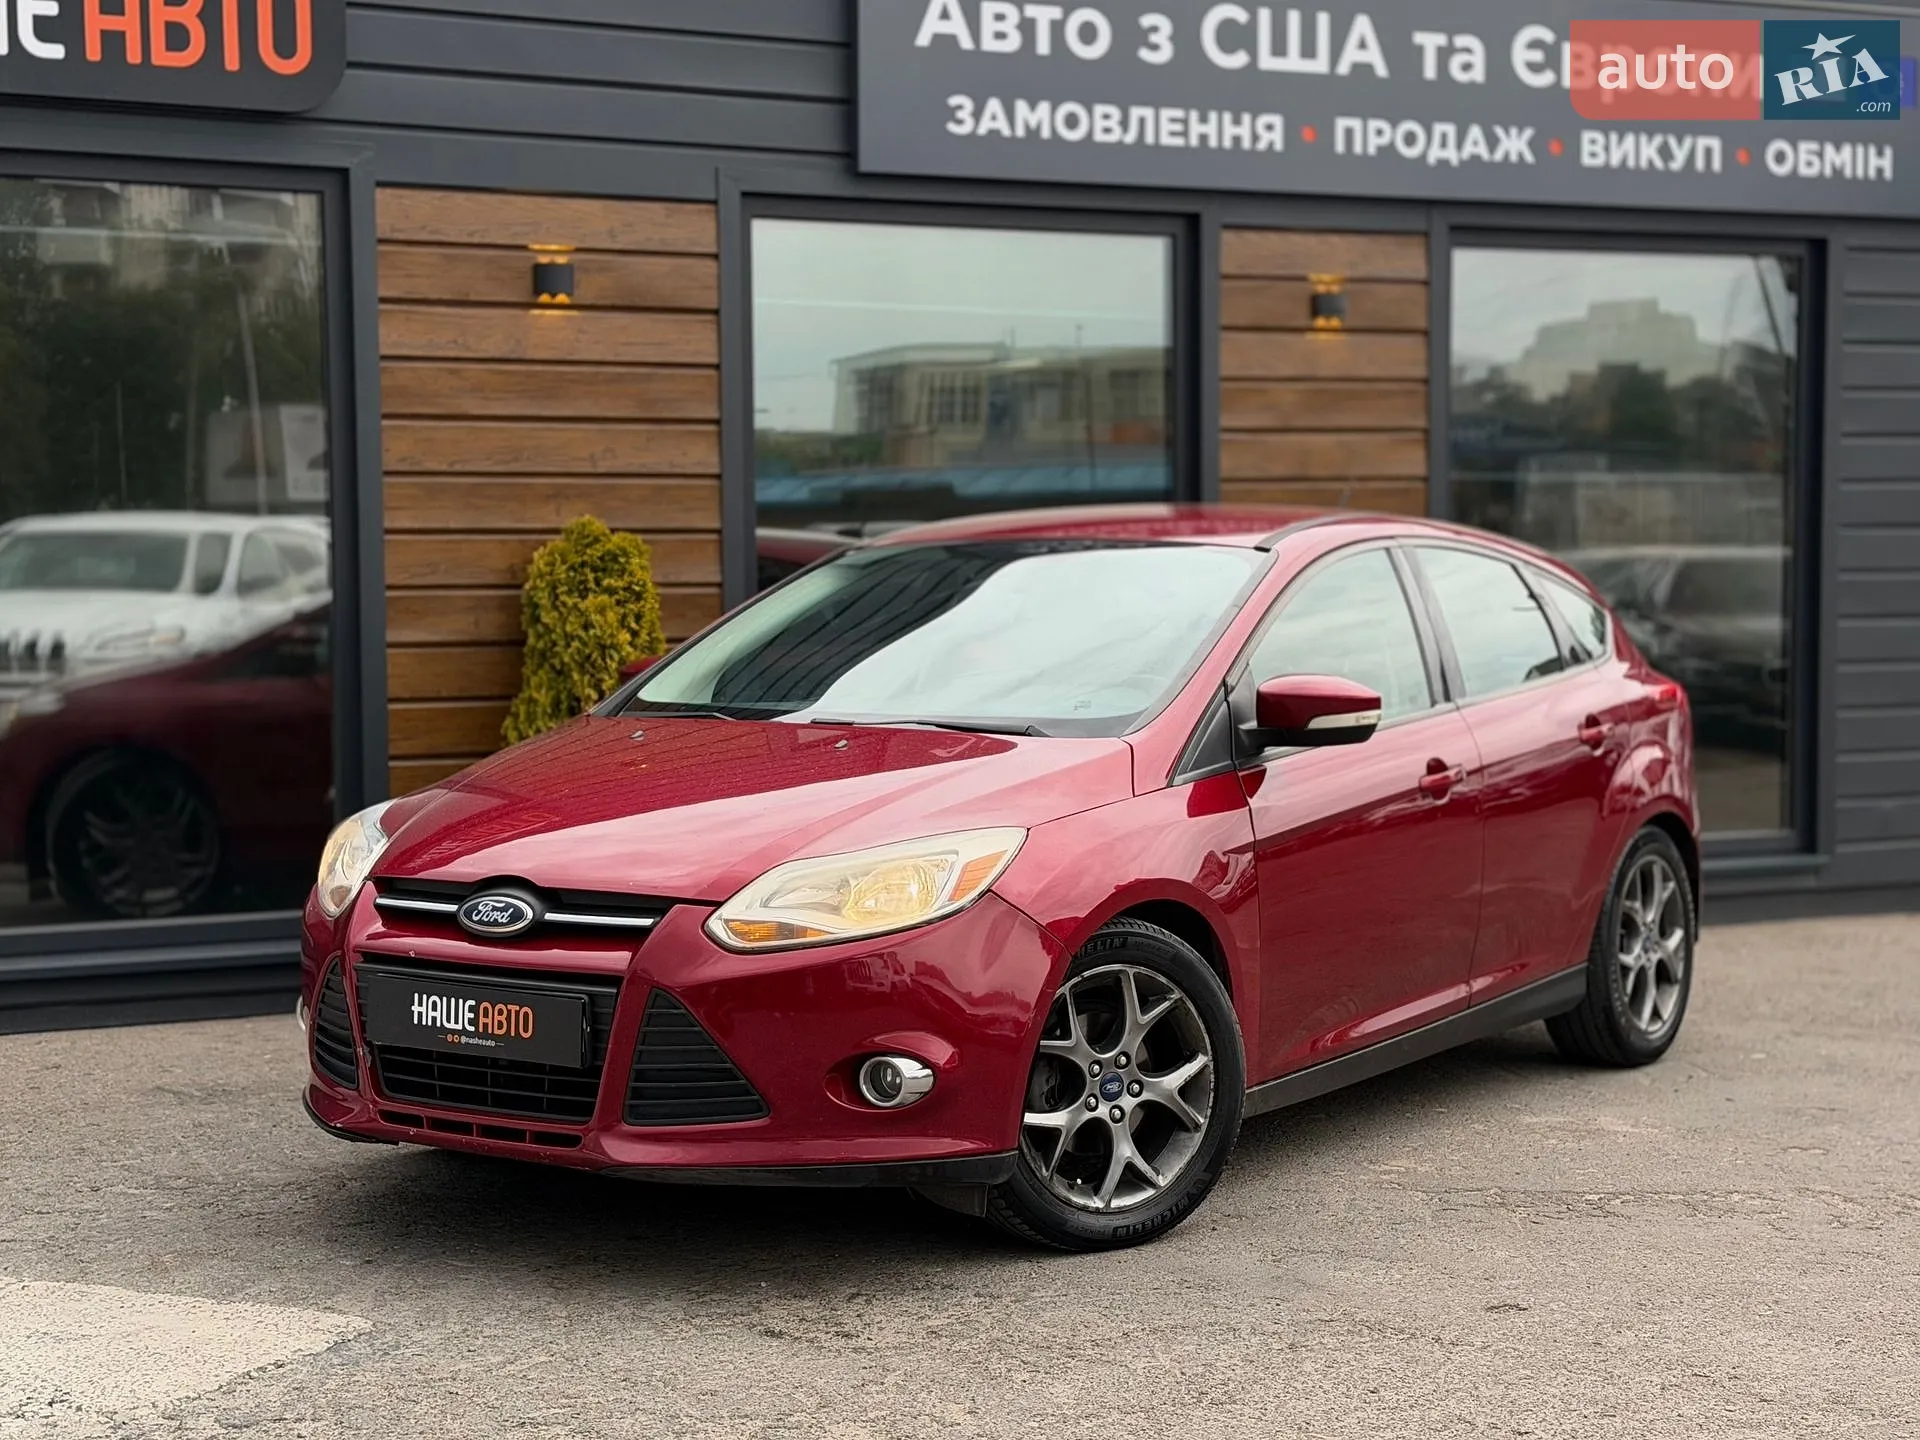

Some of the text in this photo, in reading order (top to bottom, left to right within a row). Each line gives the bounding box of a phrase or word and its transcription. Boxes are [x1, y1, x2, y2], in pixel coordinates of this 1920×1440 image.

[914, 0, 1112, 60] Авто
[1200, 3, 1389, 78] США
[1412, 31, 1486, 84] та
[945, 94, 1894, 181] ЗАМОВЛЕННЯ ПРОДАЖ ВИКУП ОБМІН
[472, 901, 514, 924] Ford
[411, 993, 534, 1039] НАШЕ АВТО
